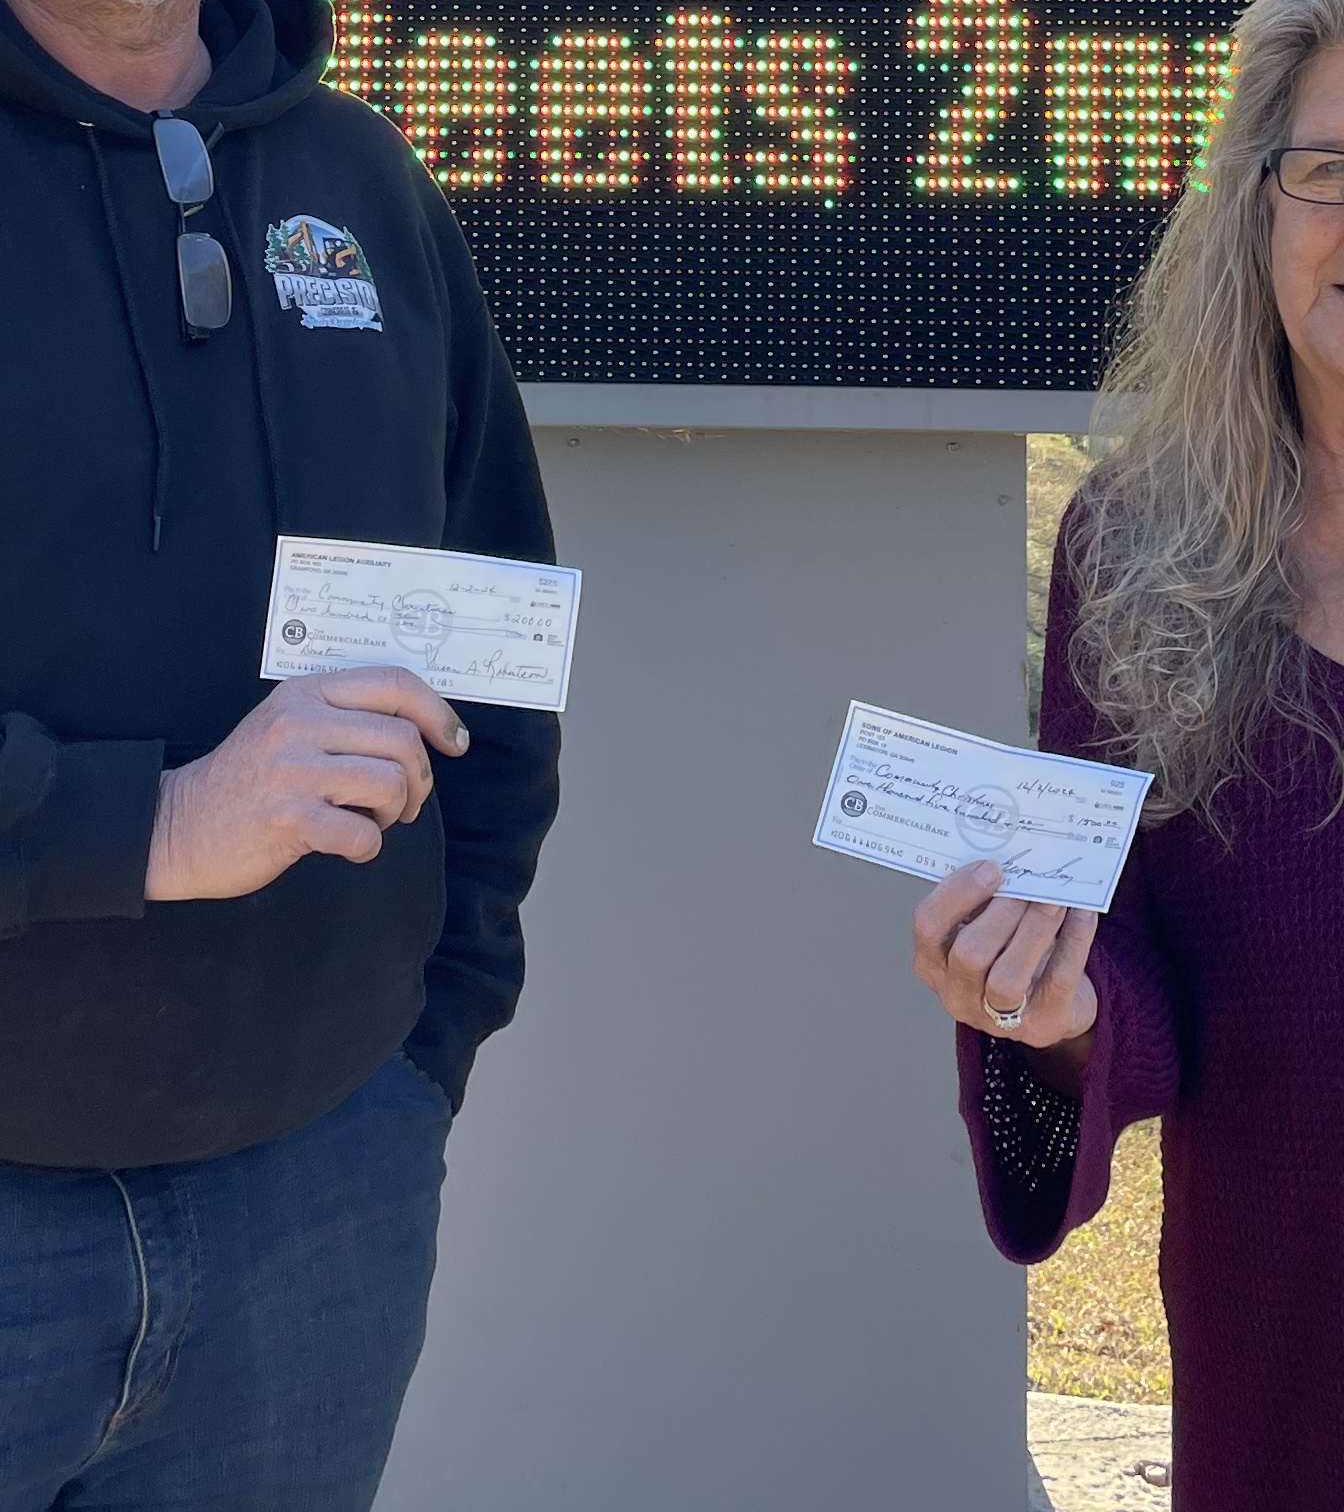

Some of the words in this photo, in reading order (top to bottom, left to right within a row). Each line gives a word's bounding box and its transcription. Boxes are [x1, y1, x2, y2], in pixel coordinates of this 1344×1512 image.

[291, 553, 327, 561] AMERICAN
[329, 555, 355, 564] LEGION
[862, 722, 881, 733] SONS
[894, 731, 931, 748] AMERICAN
[931, 742, 958, 755] LEGION
[845, 795, 863, 812] CB
